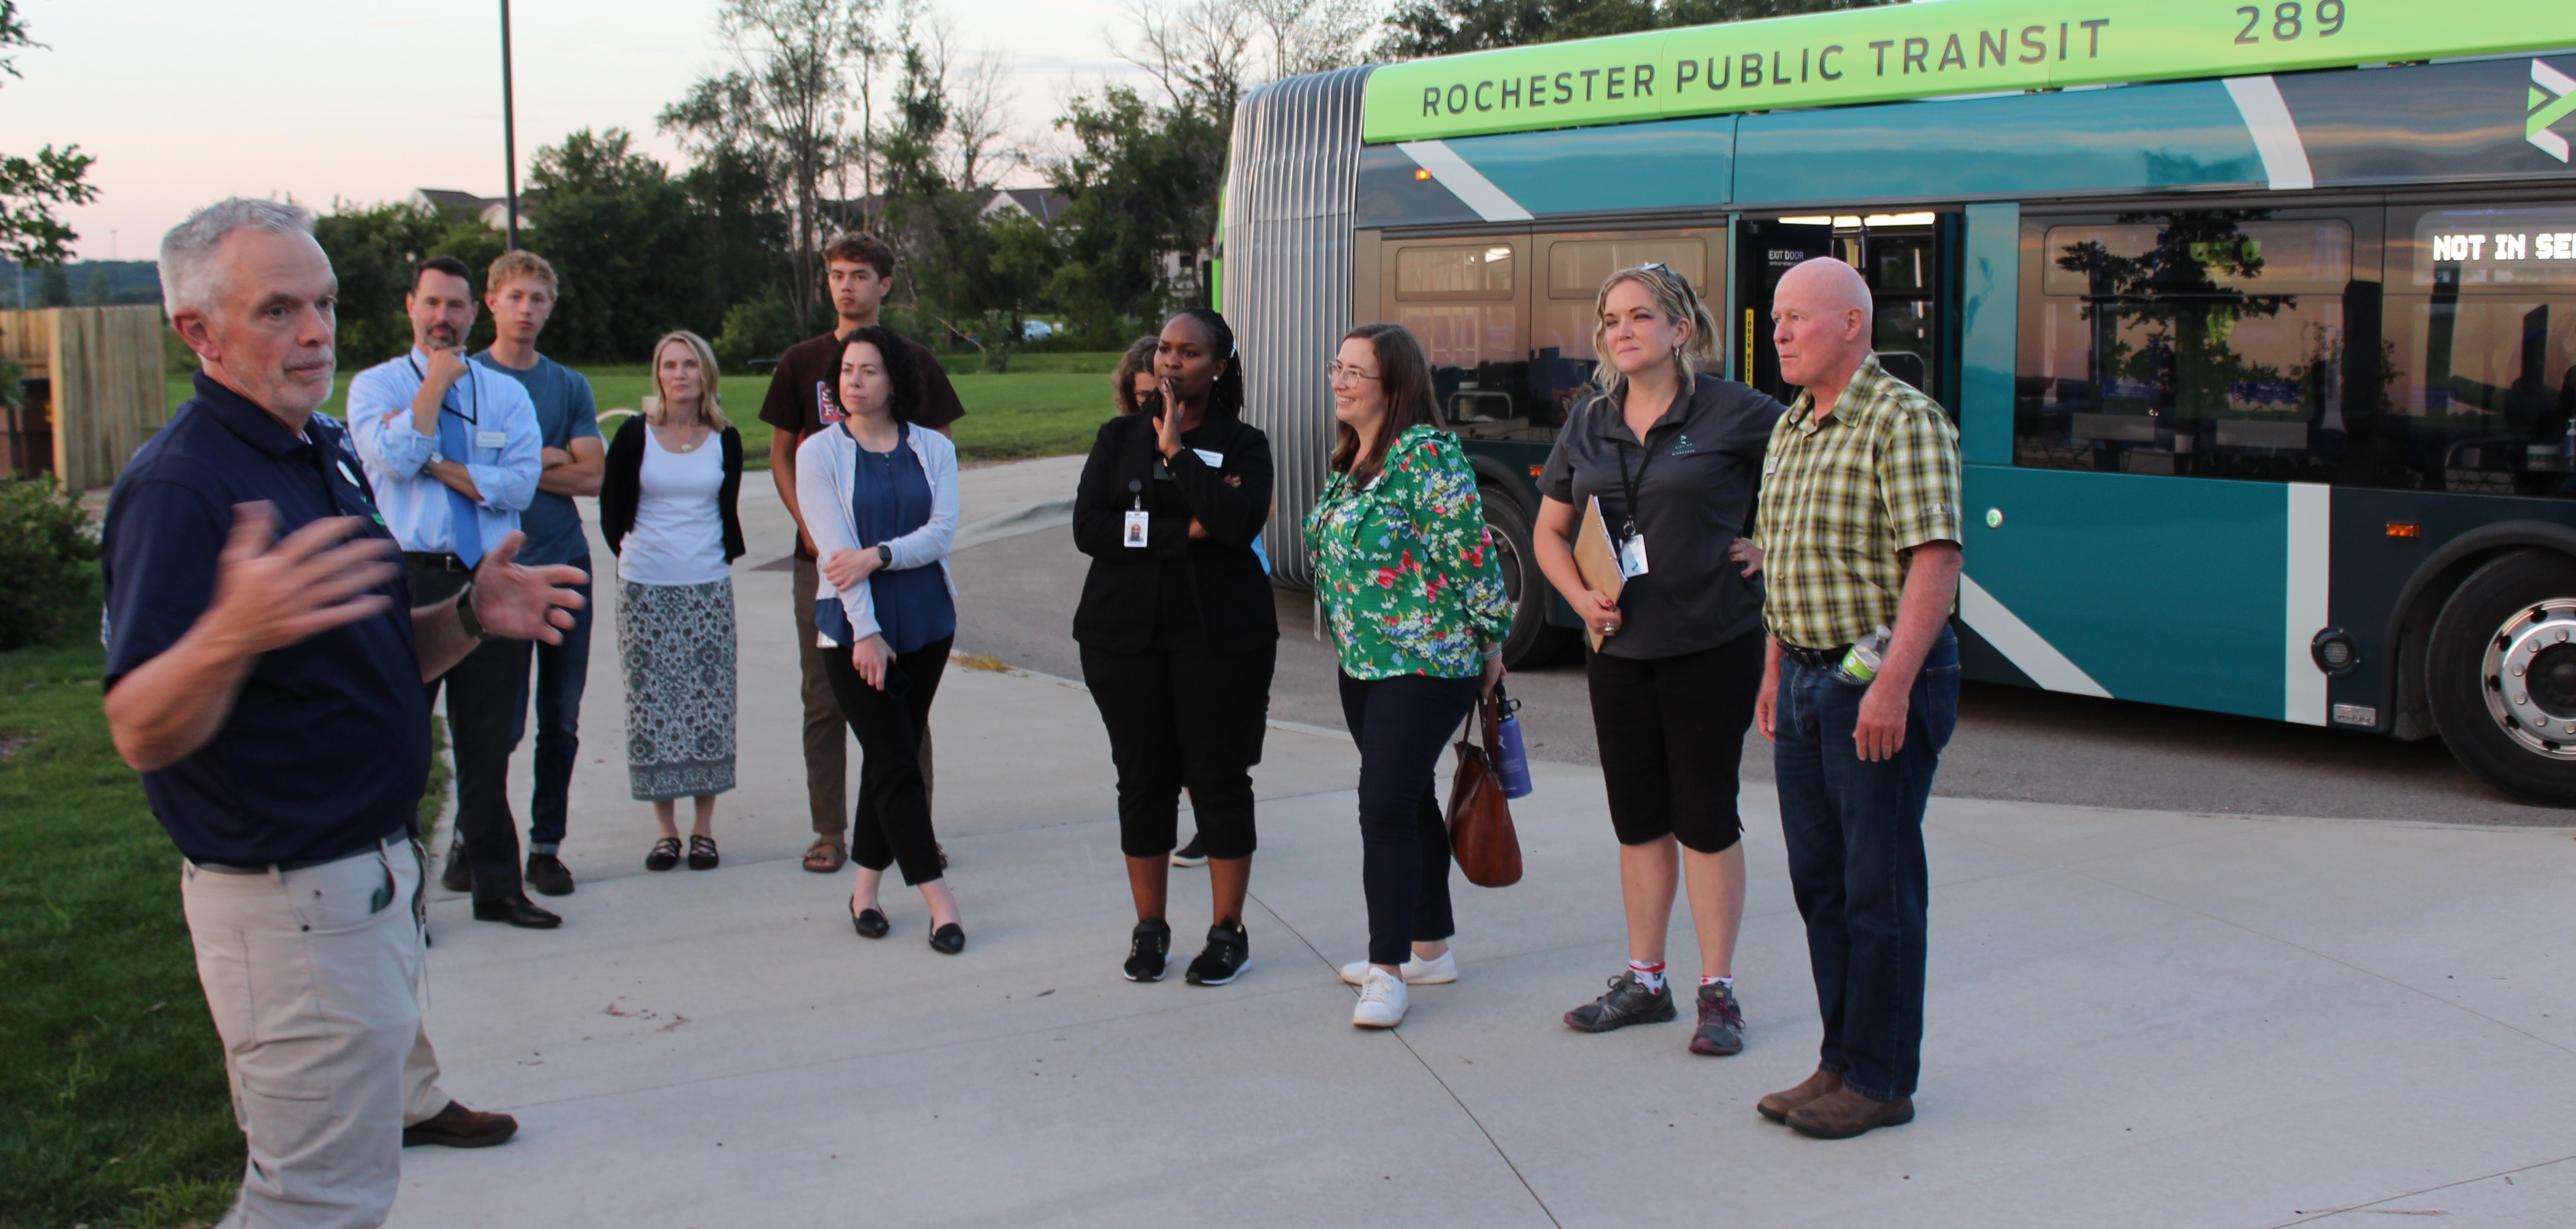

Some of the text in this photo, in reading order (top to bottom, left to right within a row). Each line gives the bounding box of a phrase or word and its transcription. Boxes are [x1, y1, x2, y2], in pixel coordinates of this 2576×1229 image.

[2234, 0, 2345, 45] 289
[1423, 19, 2110, 117] ROCHESTER PUBLIC TRANSIT
[1769, 250, 1804, 260] EXIT DOOR
[2433, 233, 2576, 261] NOT IN SE
